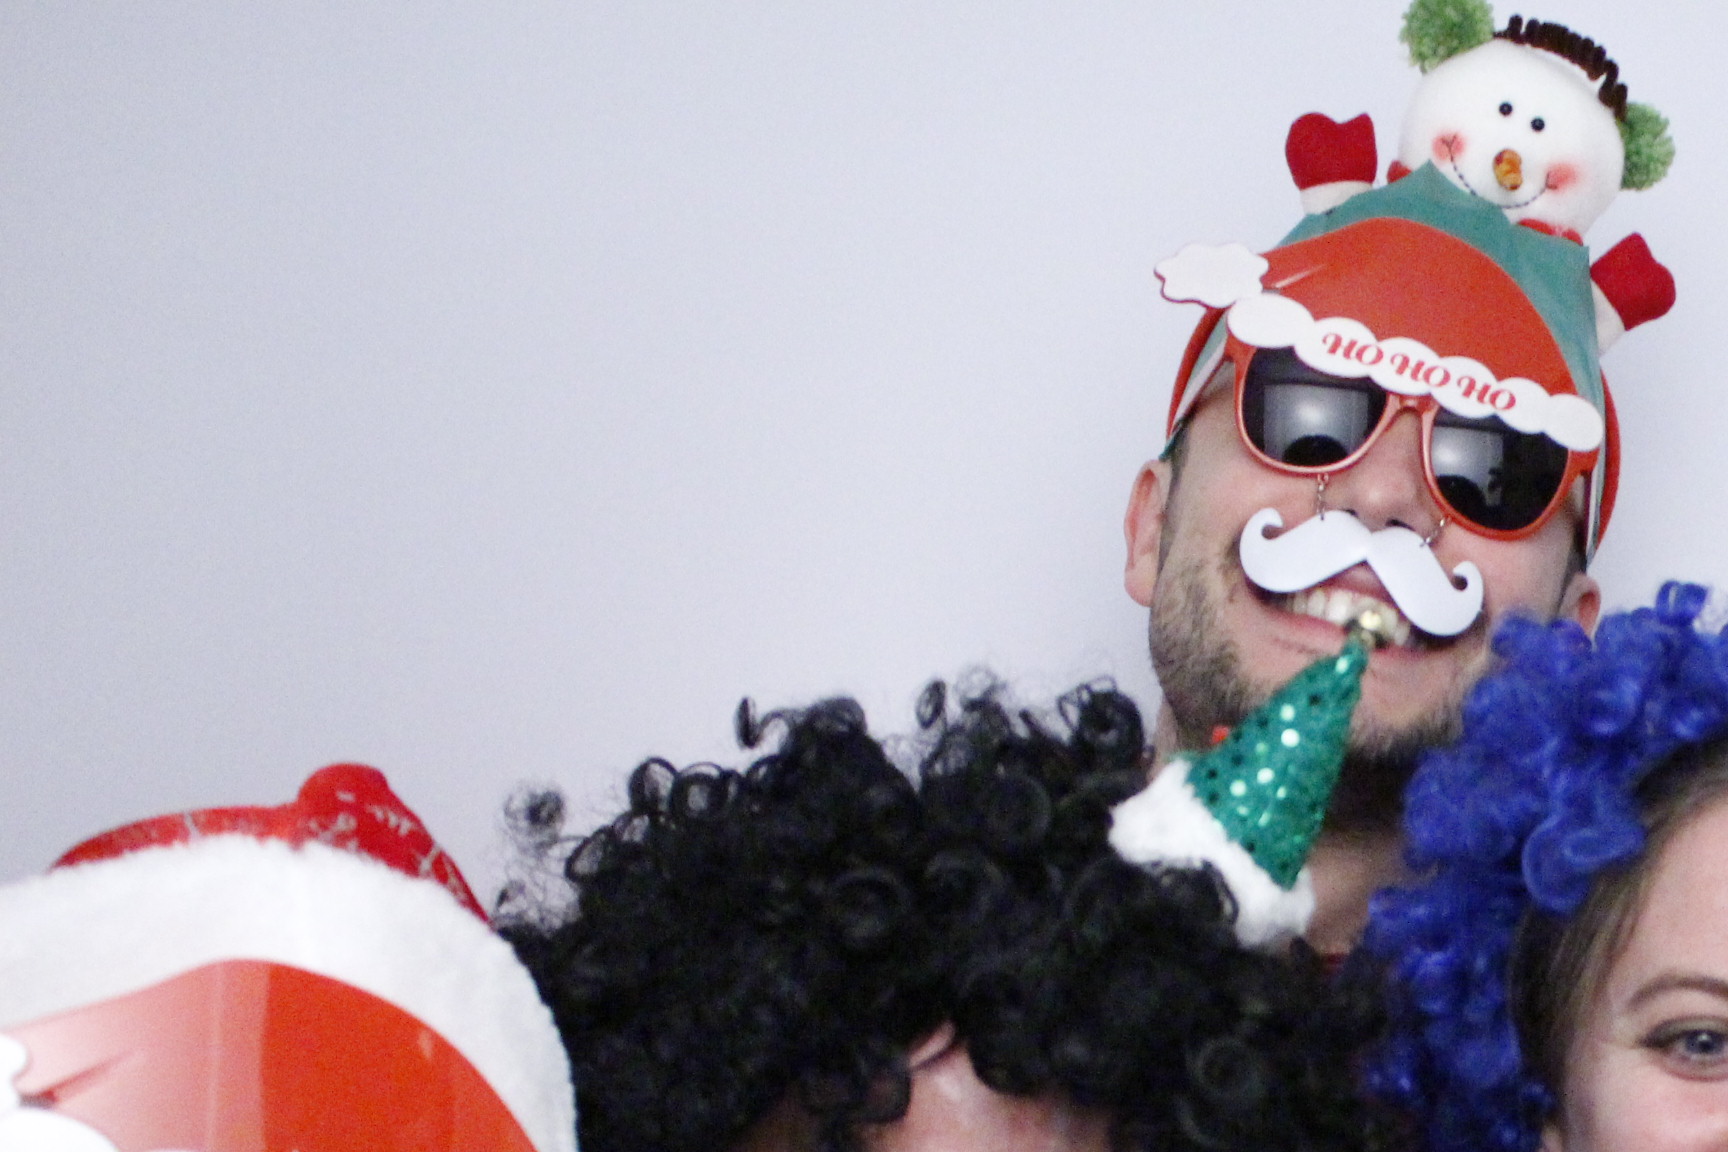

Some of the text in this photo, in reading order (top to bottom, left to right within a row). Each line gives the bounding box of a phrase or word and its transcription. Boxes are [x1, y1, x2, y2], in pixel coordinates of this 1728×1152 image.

[1321, 332, 1517, 411] HO HO HO
